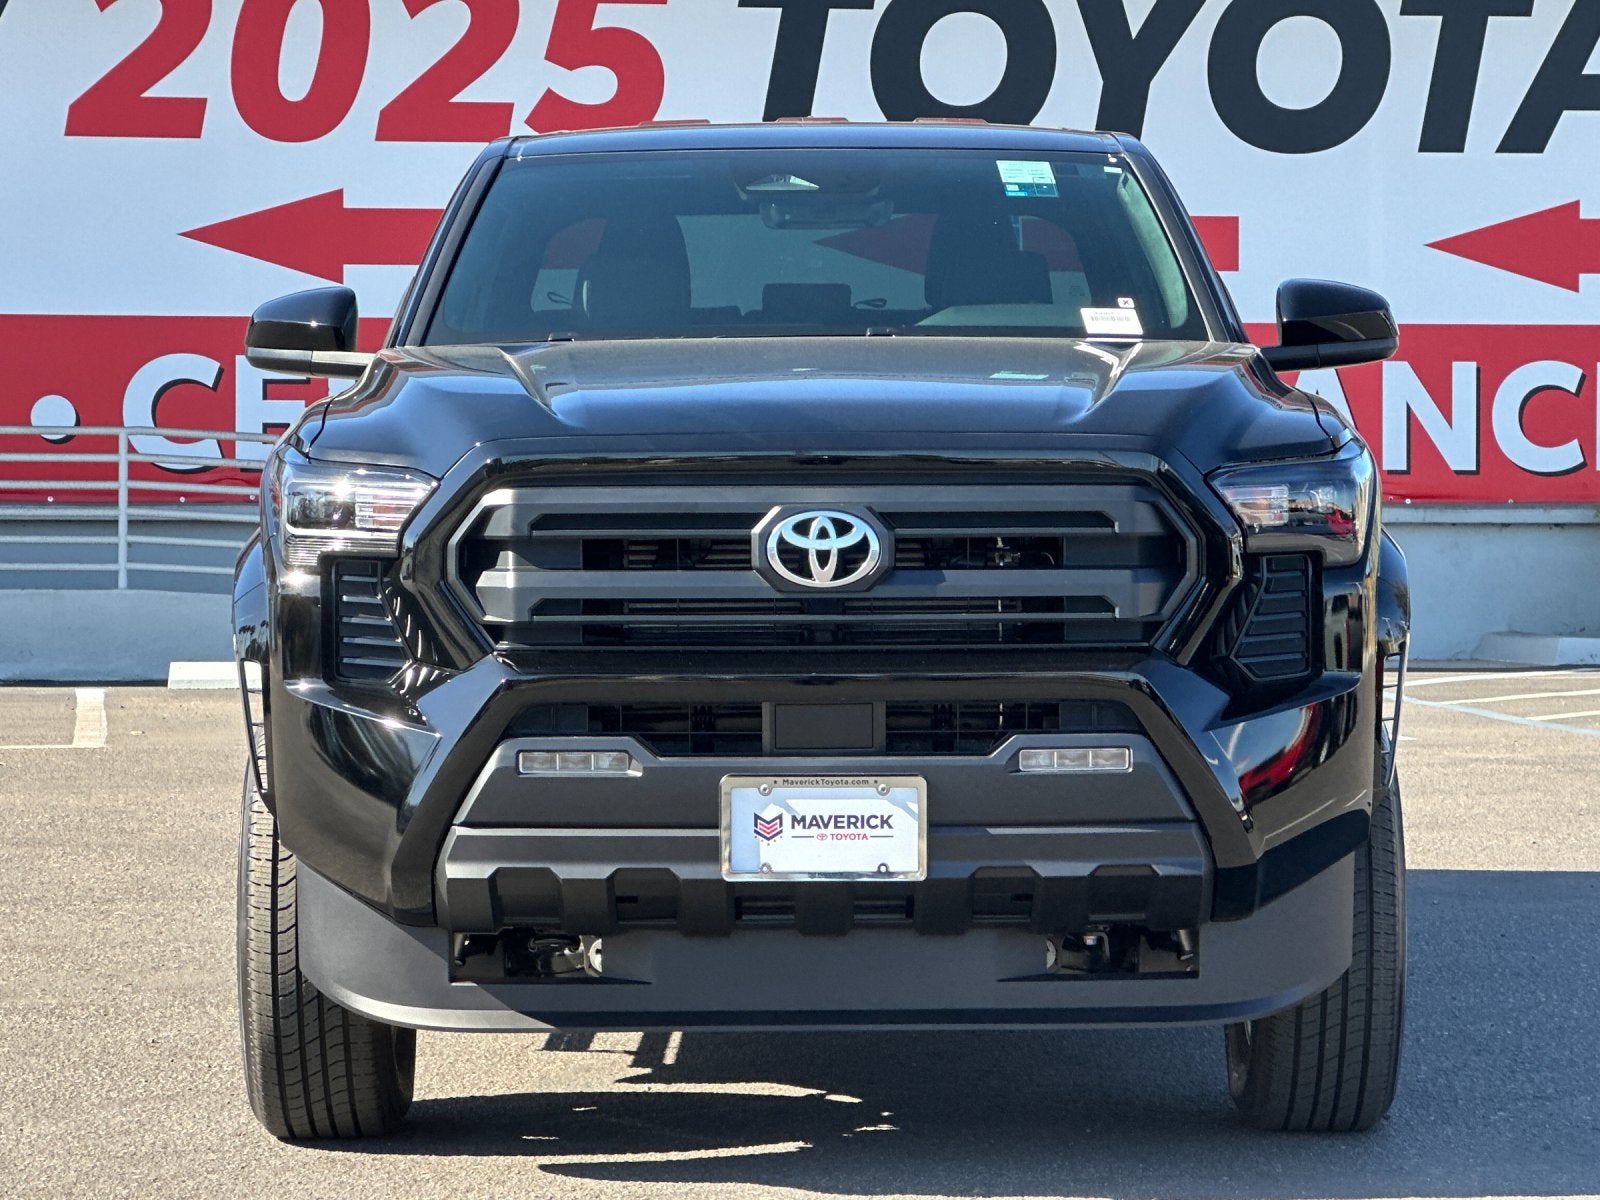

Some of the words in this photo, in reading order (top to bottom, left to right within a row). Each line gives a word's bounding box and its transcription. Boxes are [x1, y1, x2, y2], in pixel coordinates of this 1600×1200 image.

[65, 0, 666, 143] 2025
[122, 352, 356, 473] CE
[782, 778, 870, 786] MaverickToyota.com
[790, 814, 894, 830] MAVERICK
[829, 833, 869, 841] TOYOTA
